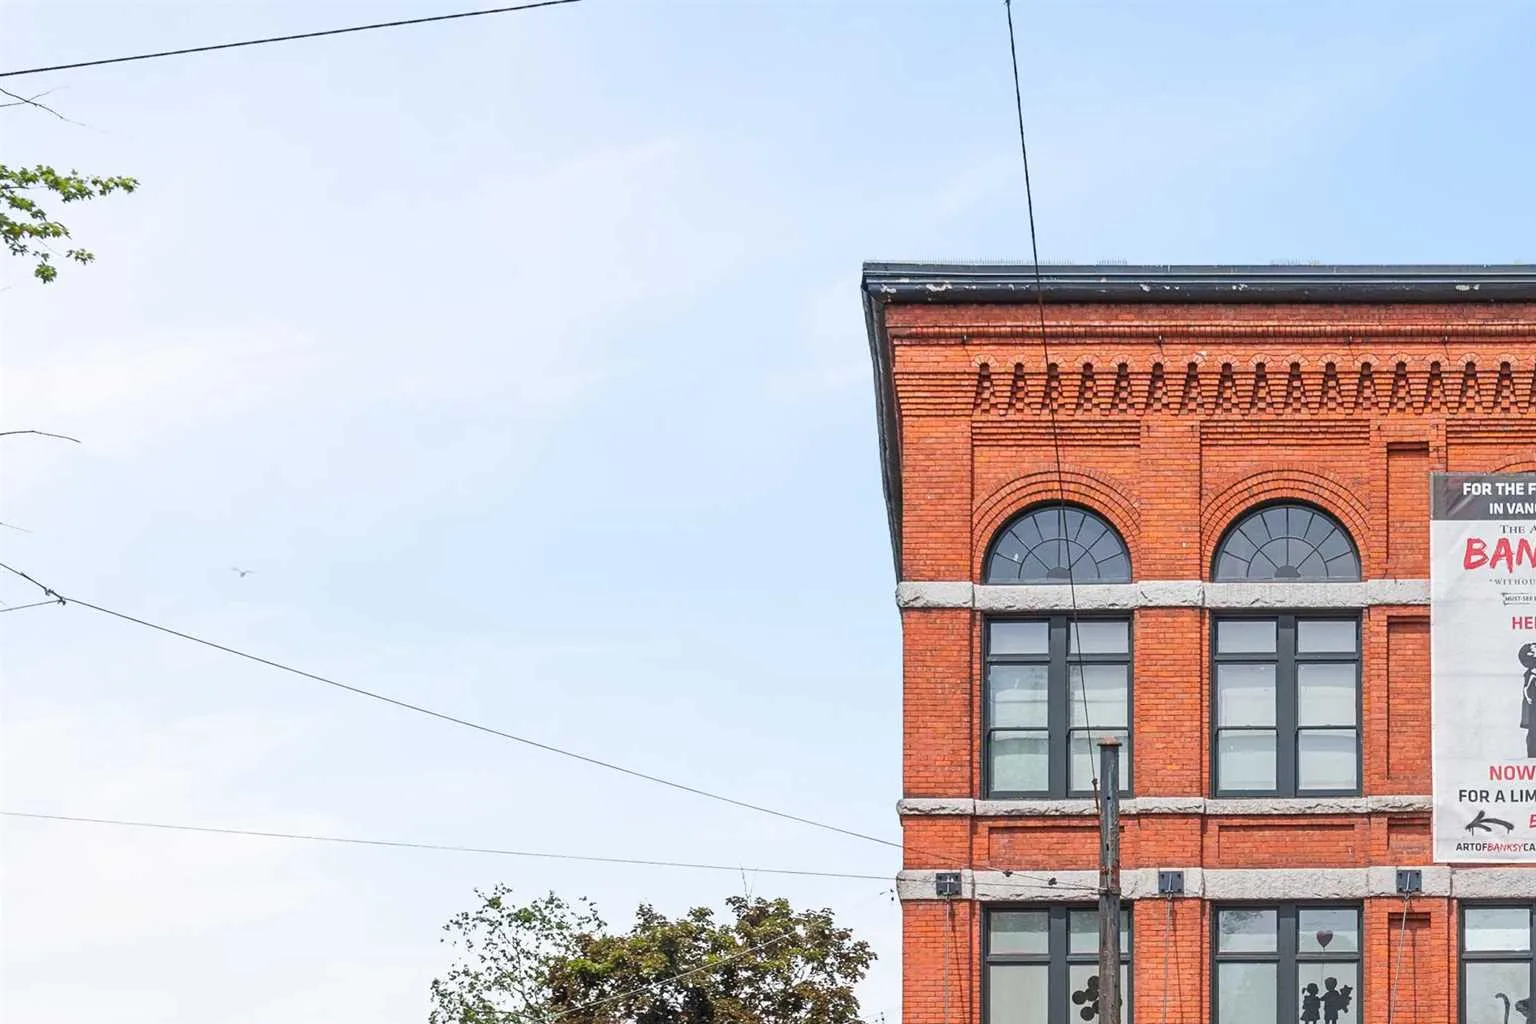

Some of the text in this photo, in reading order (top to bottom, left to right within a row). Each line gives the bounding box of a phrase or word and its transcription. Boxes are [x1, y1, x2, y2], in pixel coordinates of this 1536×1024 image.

[1463, 482, 1492, 496] FOR
[1495, 482, 1524, 495] THE
[1489, 503, 1503, 515] IN
[1500, 524, 1525, 534] THE
[1489, 765, 1536, 780] NOW
[1458, 789, 1490, 803] FOR
[1494, 789, 1506, 802] A
